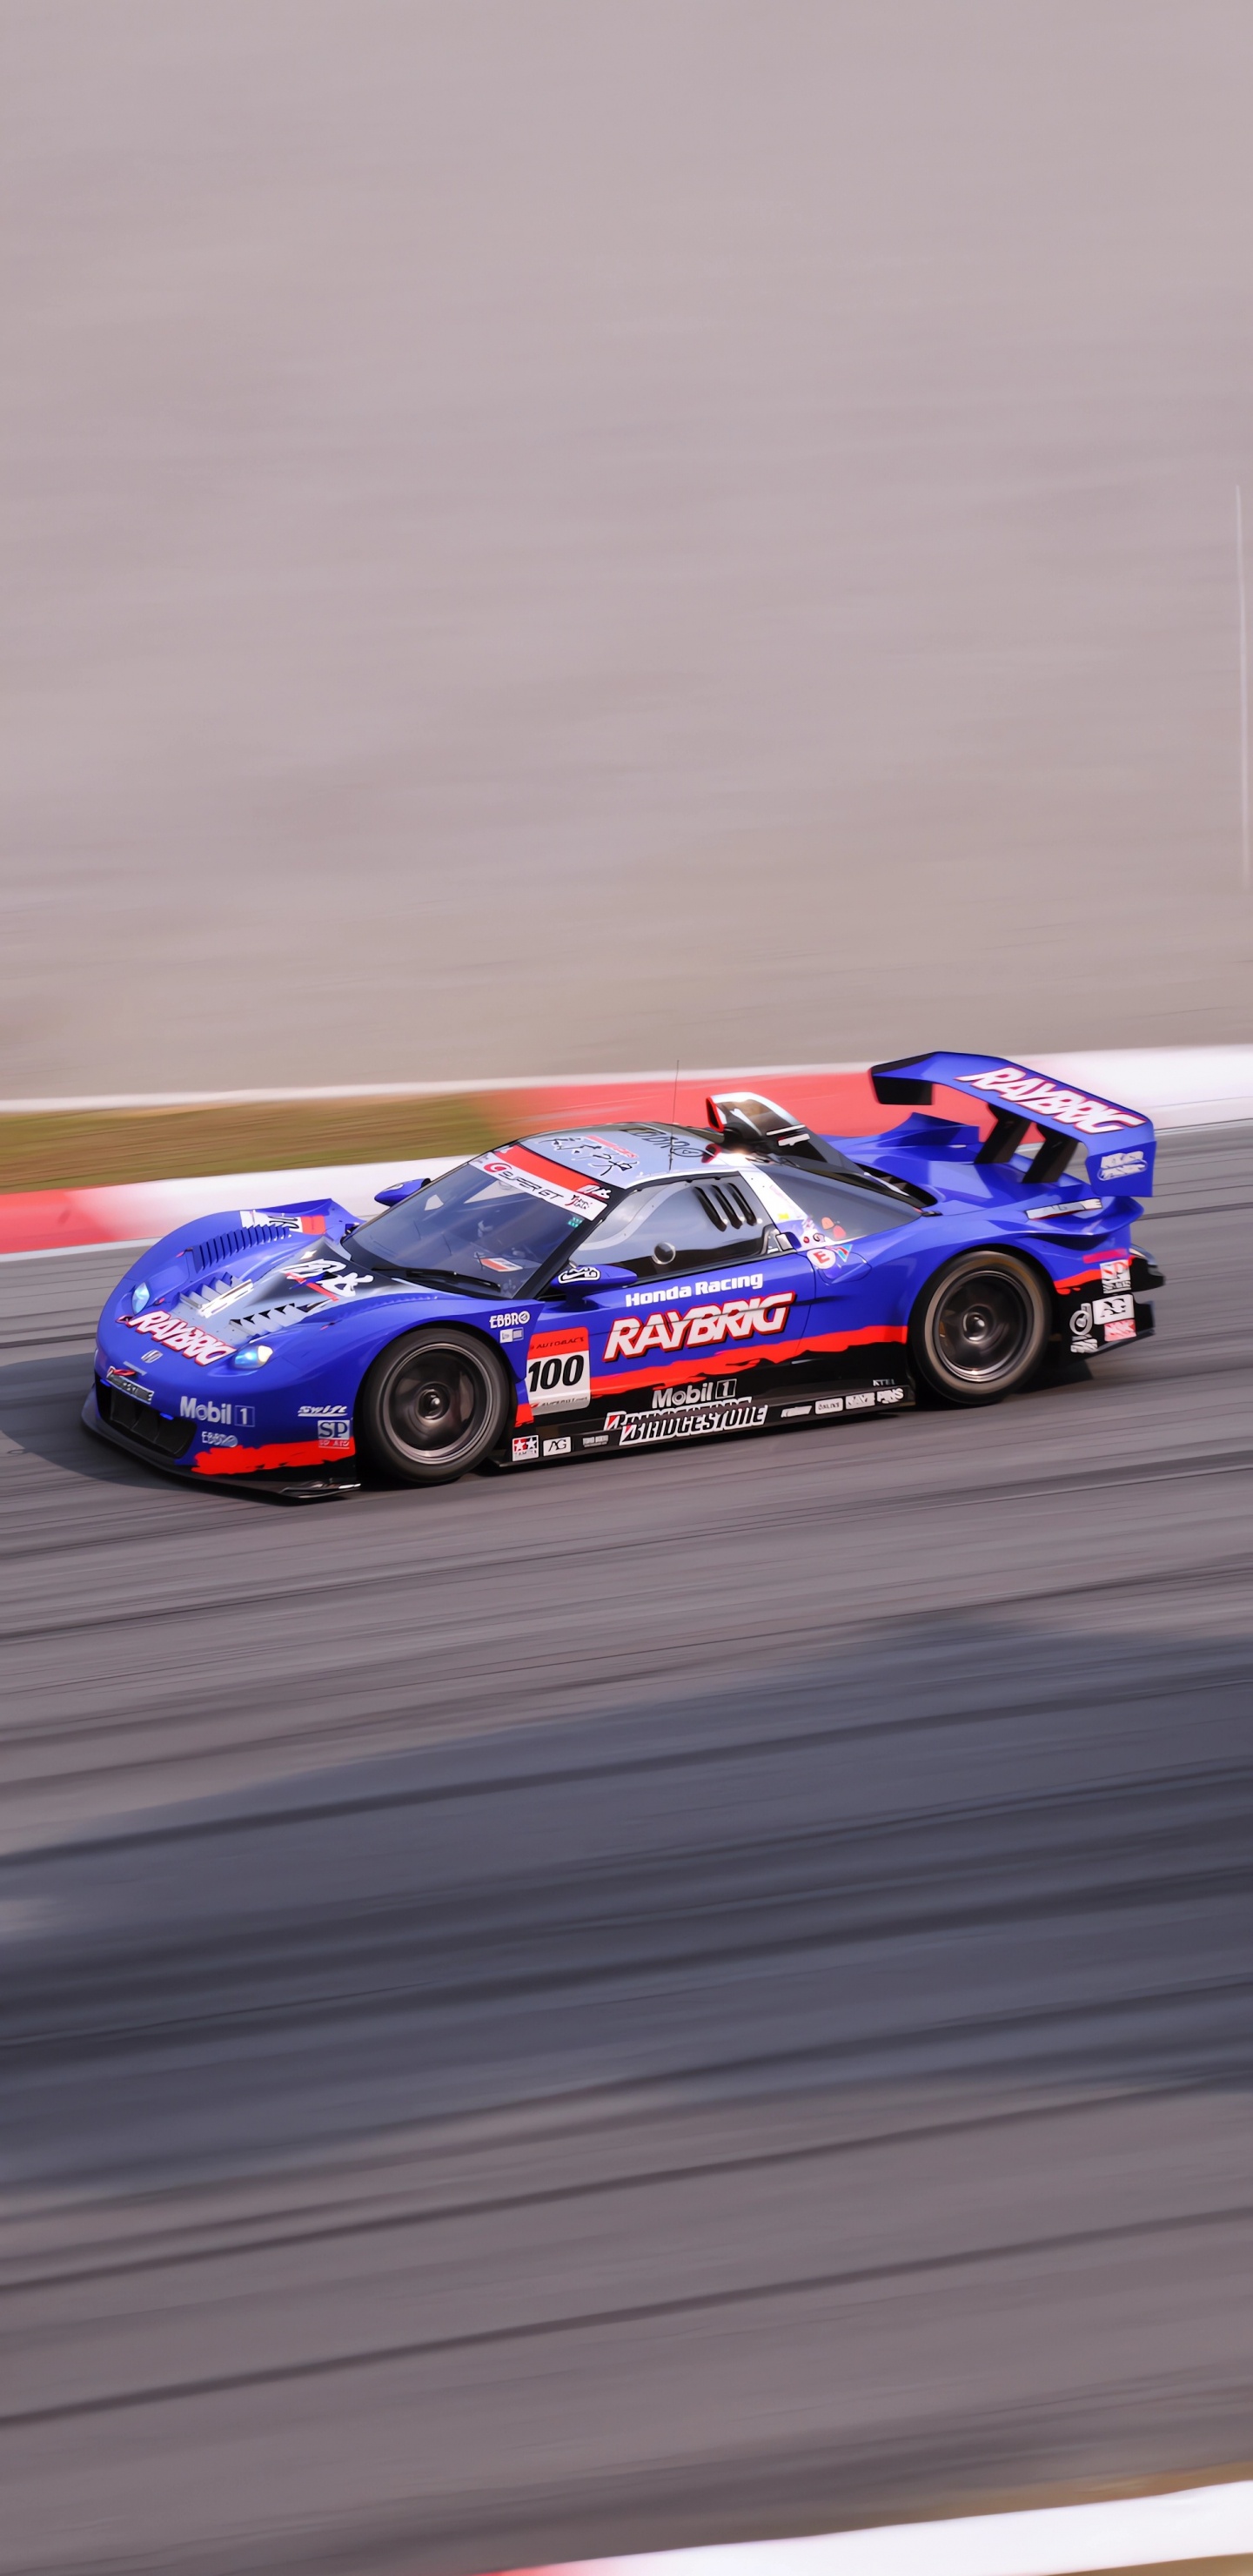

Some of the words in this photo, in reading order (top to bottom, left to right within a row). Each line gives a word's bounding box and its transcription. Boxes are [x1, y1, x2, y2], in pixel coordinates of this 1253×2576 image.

[954, 1066, 1146, 1135] RAYBRIG
[625, 1285, 693, 1307] Honda
[695, 1273, 763, 1295] Racing
[489, 1311, 530, 1329] EBBRO
[602, 1291, 796, 1362] RAYBRIG
[528, 1354, 584, 1392] 100
[180, 1396, 231, 1425] Mobil
[652, 1382, 714, 1409] Mobil
[318, 1421, 348, 1439] SP
